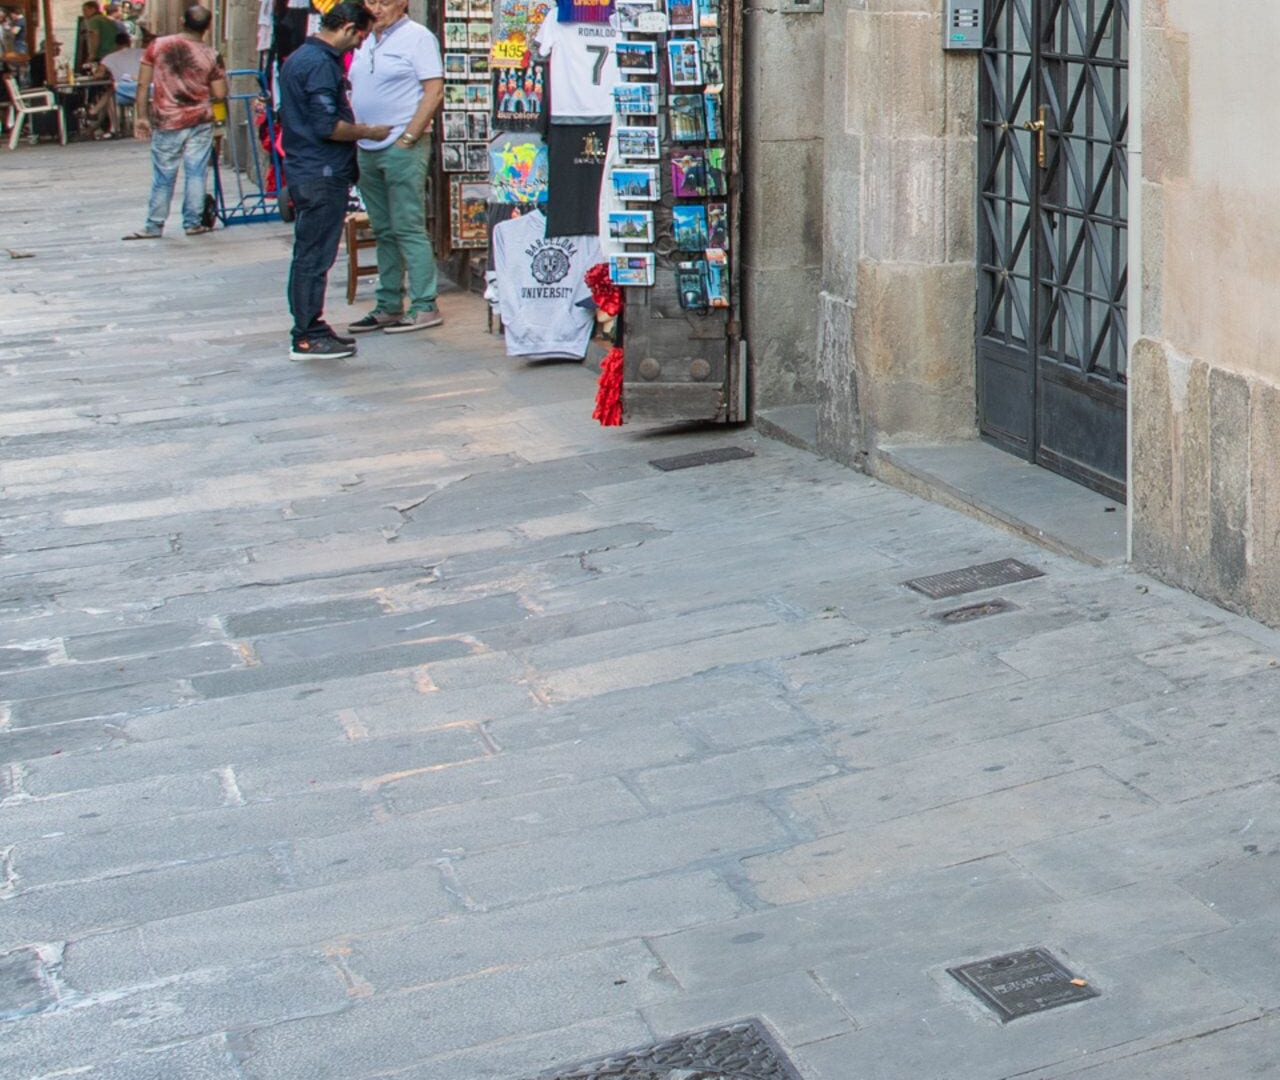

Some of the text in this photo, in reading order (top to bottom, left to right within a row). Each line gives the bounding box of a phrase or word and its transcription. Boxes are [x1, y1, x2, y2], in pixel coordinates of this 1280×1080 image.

[578, 27, 616, 38] RONALDO
[586, 44, 609, 86] 7
[525, 238, 578, 258] BARCELONA
